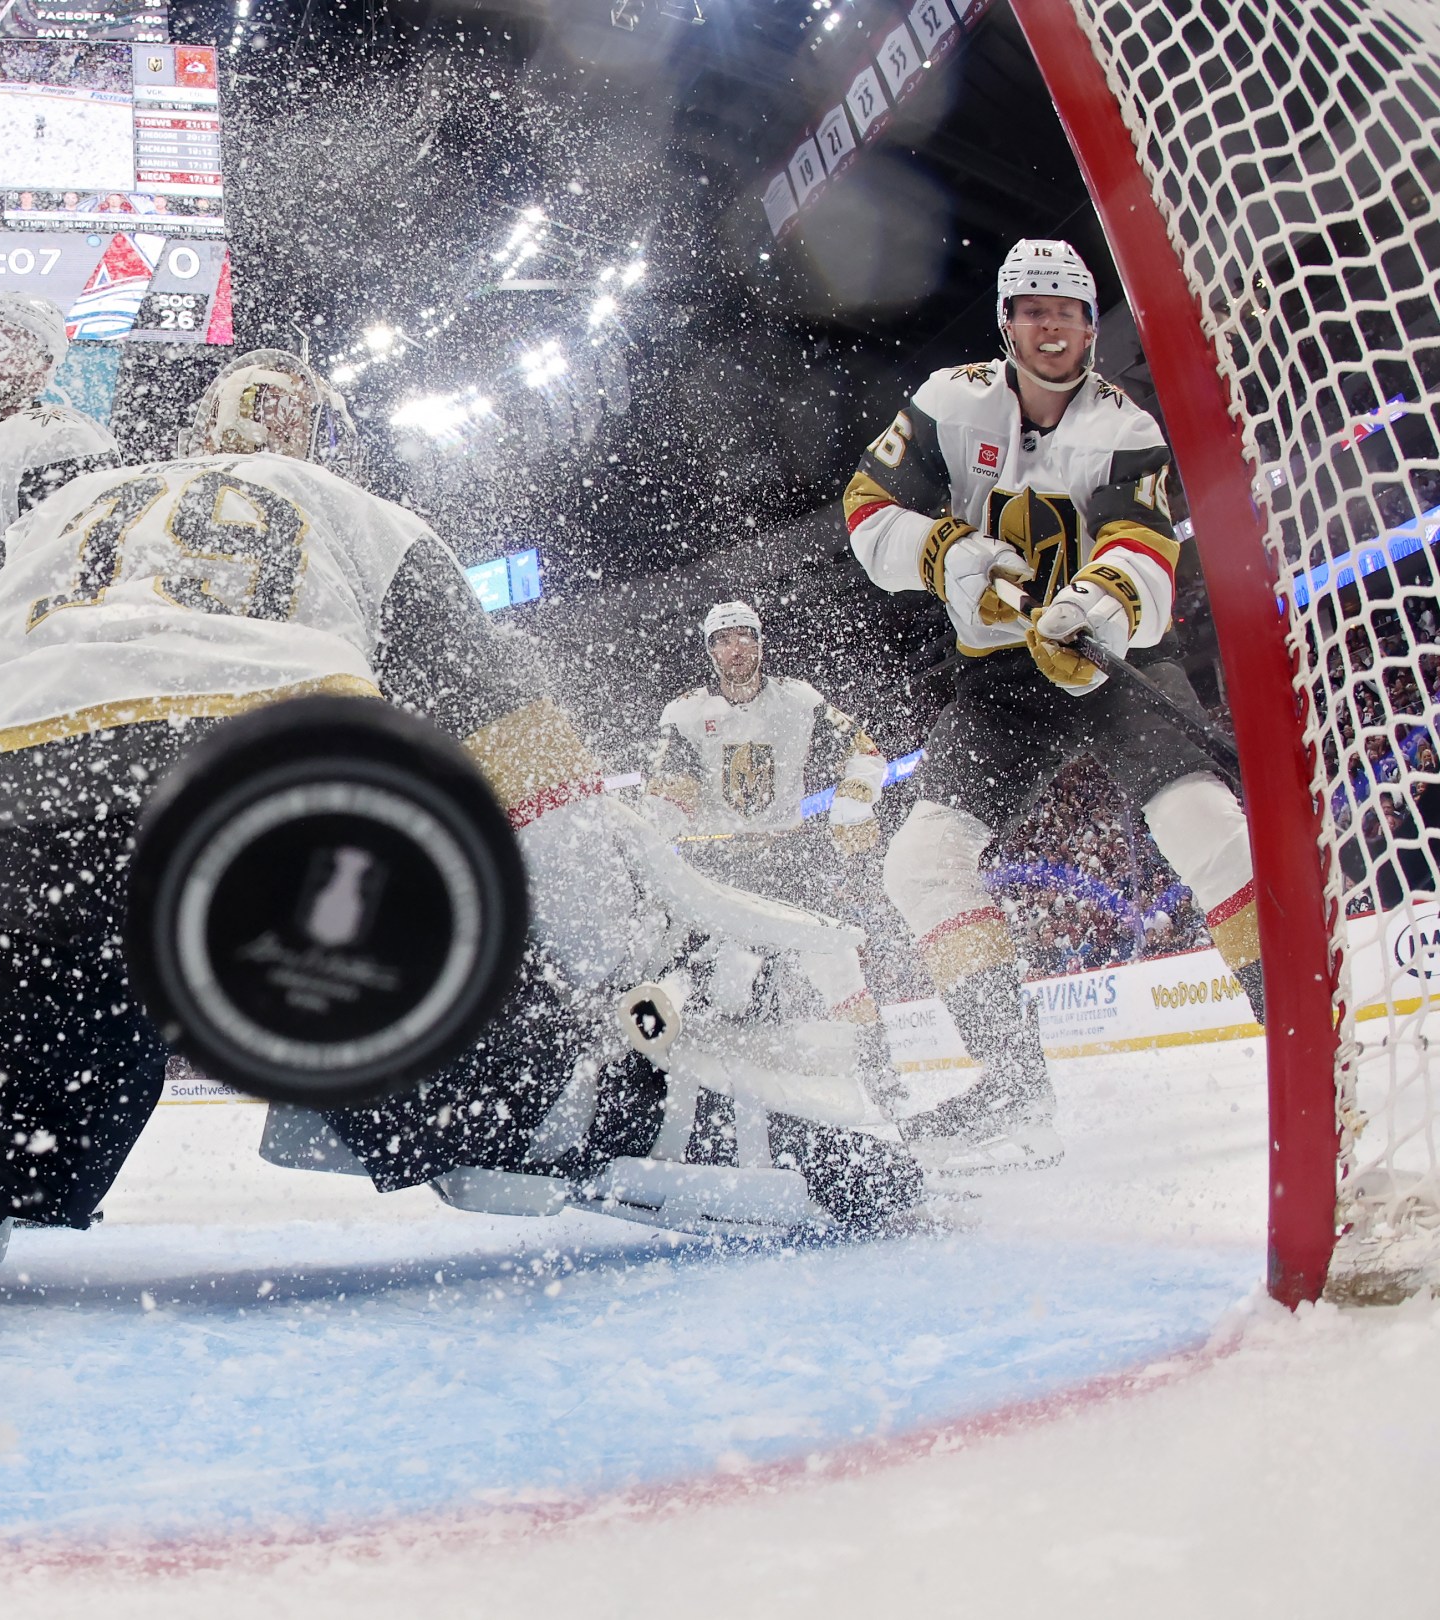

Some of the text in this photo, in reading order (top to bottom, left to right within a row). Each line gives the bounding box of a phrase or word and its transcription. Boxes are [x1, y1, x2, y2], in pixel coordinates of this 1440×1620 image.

[36, 10, 163, 24] FACEOFF % .490
[921, 5, 942, 38] 52
[36, 29, 73, 38] SAVE
[76, 29, 89, 39] %
[889, 44, 907, 79] 33
[858, 86, 874, 120] 23
[139, 118, 212, 129] TOEWS 21:15
[827, 126, 843, 156] 21
[140, 172, 171, 181] NECAS
[799, 157, 814, 187] 19
[74, 221, 92, 229] MPH
[119, 222, 137, 230] MPH
[164, 224, 181, 232] MPH
[207, 226, 224, 235] MPH
[1033, 247, 1053, 258] 16
[167, 247, 200, 280] 0
[158, 294, 196, 309] SOG
[160, 309, 195, 330] 26
[972, 466, 1000, 479] TOYOTA
[1184, 521, 1192, 535] 3
[25, 470, 310, 634] 79
[1090, 566, 1142, 634] BAU
[1151, 981, 1208, 1010] VOODOO
[171, 1084, 236, 1096] Southwest
